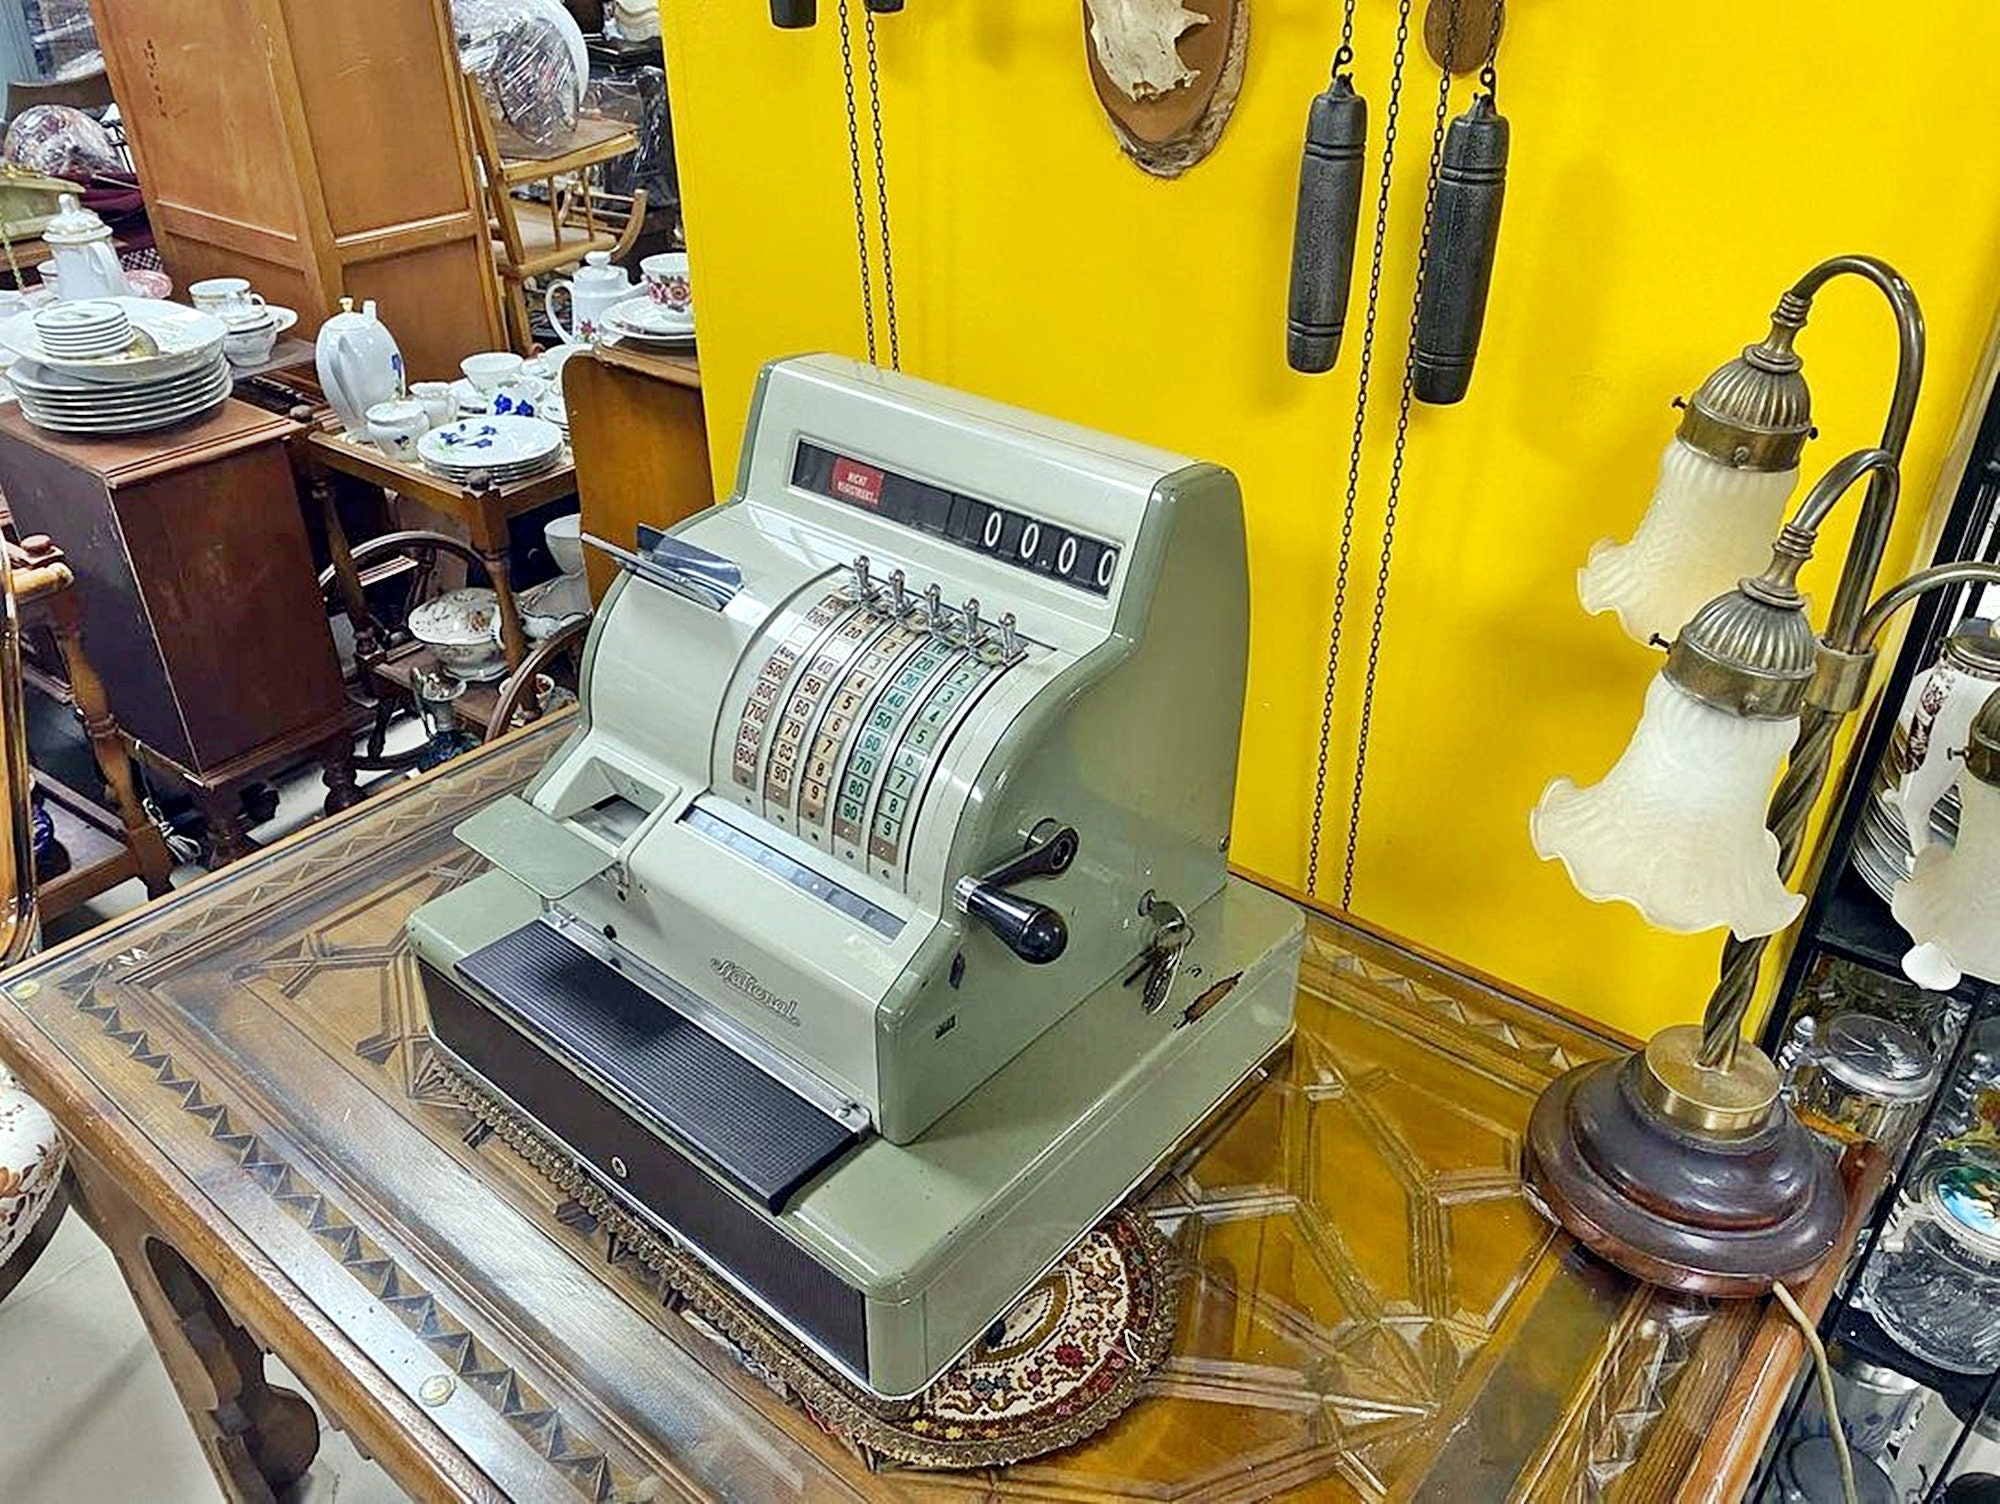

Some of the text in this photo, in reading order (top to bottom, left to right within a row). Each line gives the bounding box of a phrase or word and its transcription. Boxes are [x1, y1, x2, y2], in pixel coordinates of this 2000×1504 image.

[844, 627, 862, 640] 20
[883, 642, 897, 654] 2
[766, 662, 788, 680] 500
[817, 660, 834, 674] 40
[916, 656, 935, 672] 20
[804, 678, 821, 695] 50
[856, 677, 867, 690] 4
[901, 673, 920, 690] 30
[956, 673, 969, 686] 2
[842, 695, 855, 711] 5
[887, 692, 906, 708] 40
[942, 691, 954, 703] 3
[794, 699, 810, 717] 60
[874, 711, 893, 730] 50
[928, 710, 940, 723] 4
[785, 721, 801, 739] 70
[832, 718, 844, 733] 6
[865, 734, 881, 752] 60
[915, 729, 928, 744] 5
[822, 739, 834, 755] 7
[737, 747, 757, 766] 900
[815, 762, 825, 778] 8
[855, 756, 872, 775] 70
[773, 766, 788, 783] 90
[895, 774, 907, 790] 7
[811, 785, 820, 800] 9
[849, 780, 864, 798] 80
[843, 803, 858, 820] 90
[888, 798, 899, 814] 8
[883, 821, 892, 836] 9
[710, 957, 801, 1027] National
